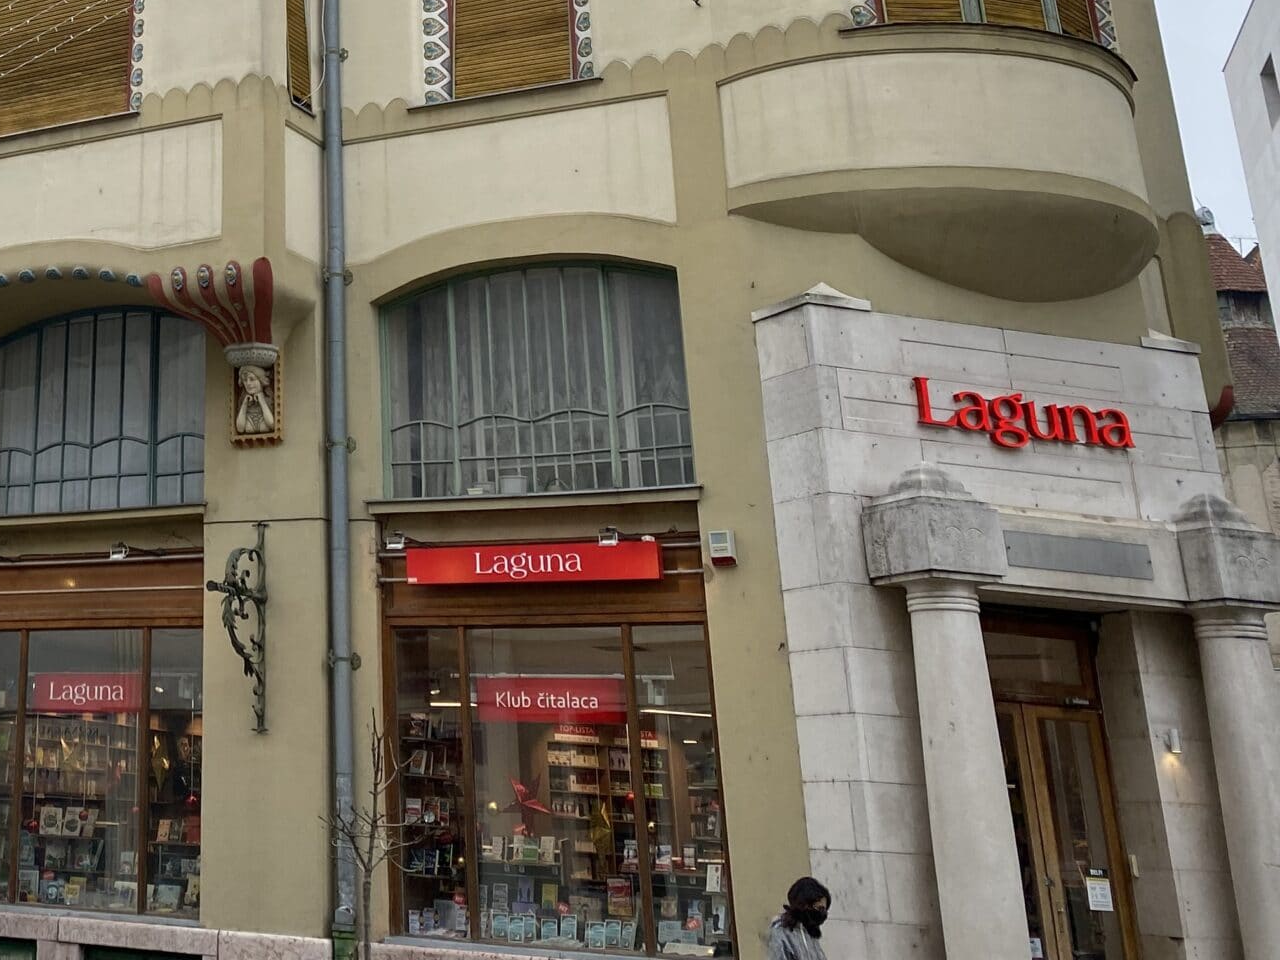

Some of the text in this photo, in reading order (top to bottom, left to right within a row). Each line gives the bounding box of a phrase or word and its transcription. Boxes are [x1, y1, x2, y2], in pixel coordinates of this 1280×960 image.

[912, 376, 1136, 448] Laguna
[474, 552, 582, 579] Laguna
[49, 681, 124, 706] Laguna
[495, 692, 599, 709] Klub čitalaca
